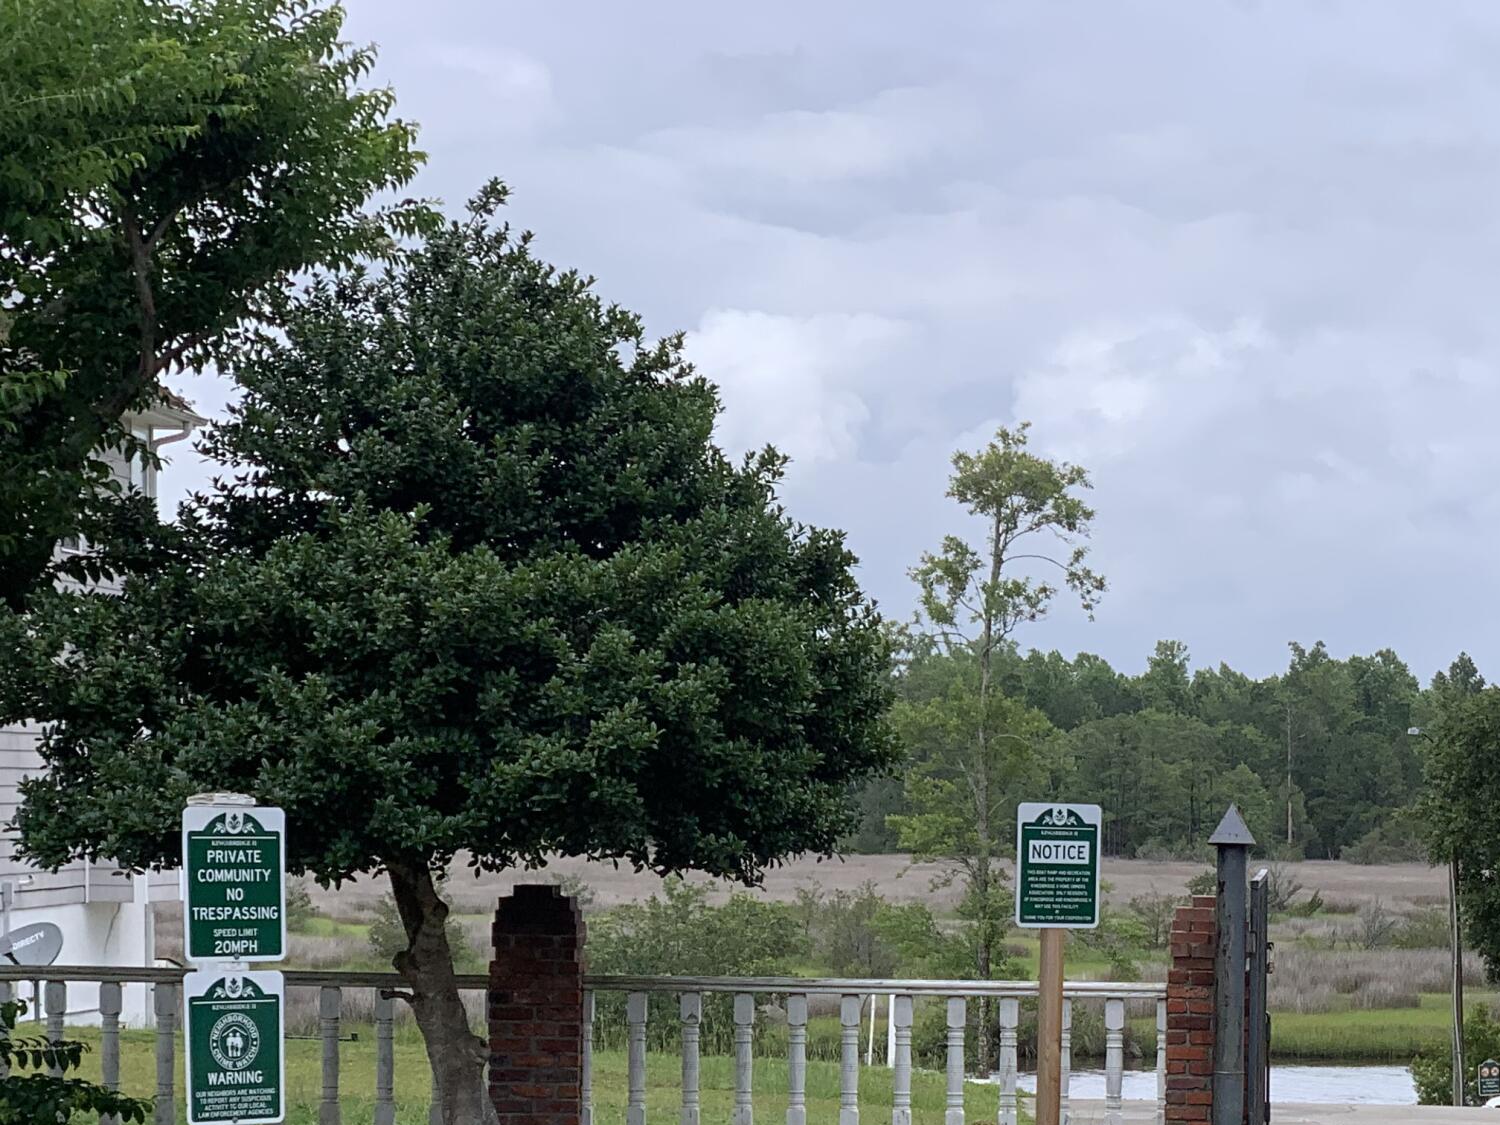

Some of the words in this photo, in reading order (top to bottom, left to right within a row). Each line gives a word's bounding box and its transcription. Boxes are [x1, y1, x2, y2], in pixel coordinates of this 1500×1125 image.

[207, 850, 261, 863] PRIVATE
[1032, 844, 1086, 860] NOTICE
[197, 869, 271, 882] COMMUNITY
[226, 888, 244, 901] NO
[192, 907, 278, 920] TRESPASSING
[213, 929, 237, 937] SPEED
[238, 928, 257, 936] LIMIT
[12, 930, 44, 950] DIRECTV
[214, 940, 257, 953] 20MPH
[212, 1014, 257, 1040] NEIGHBORHOOD
[212, 1048, 234, 1069] CRIME
[236, 1046, 256, 1068] WATCH
[208, 1071, 263, 1085] WARNING
